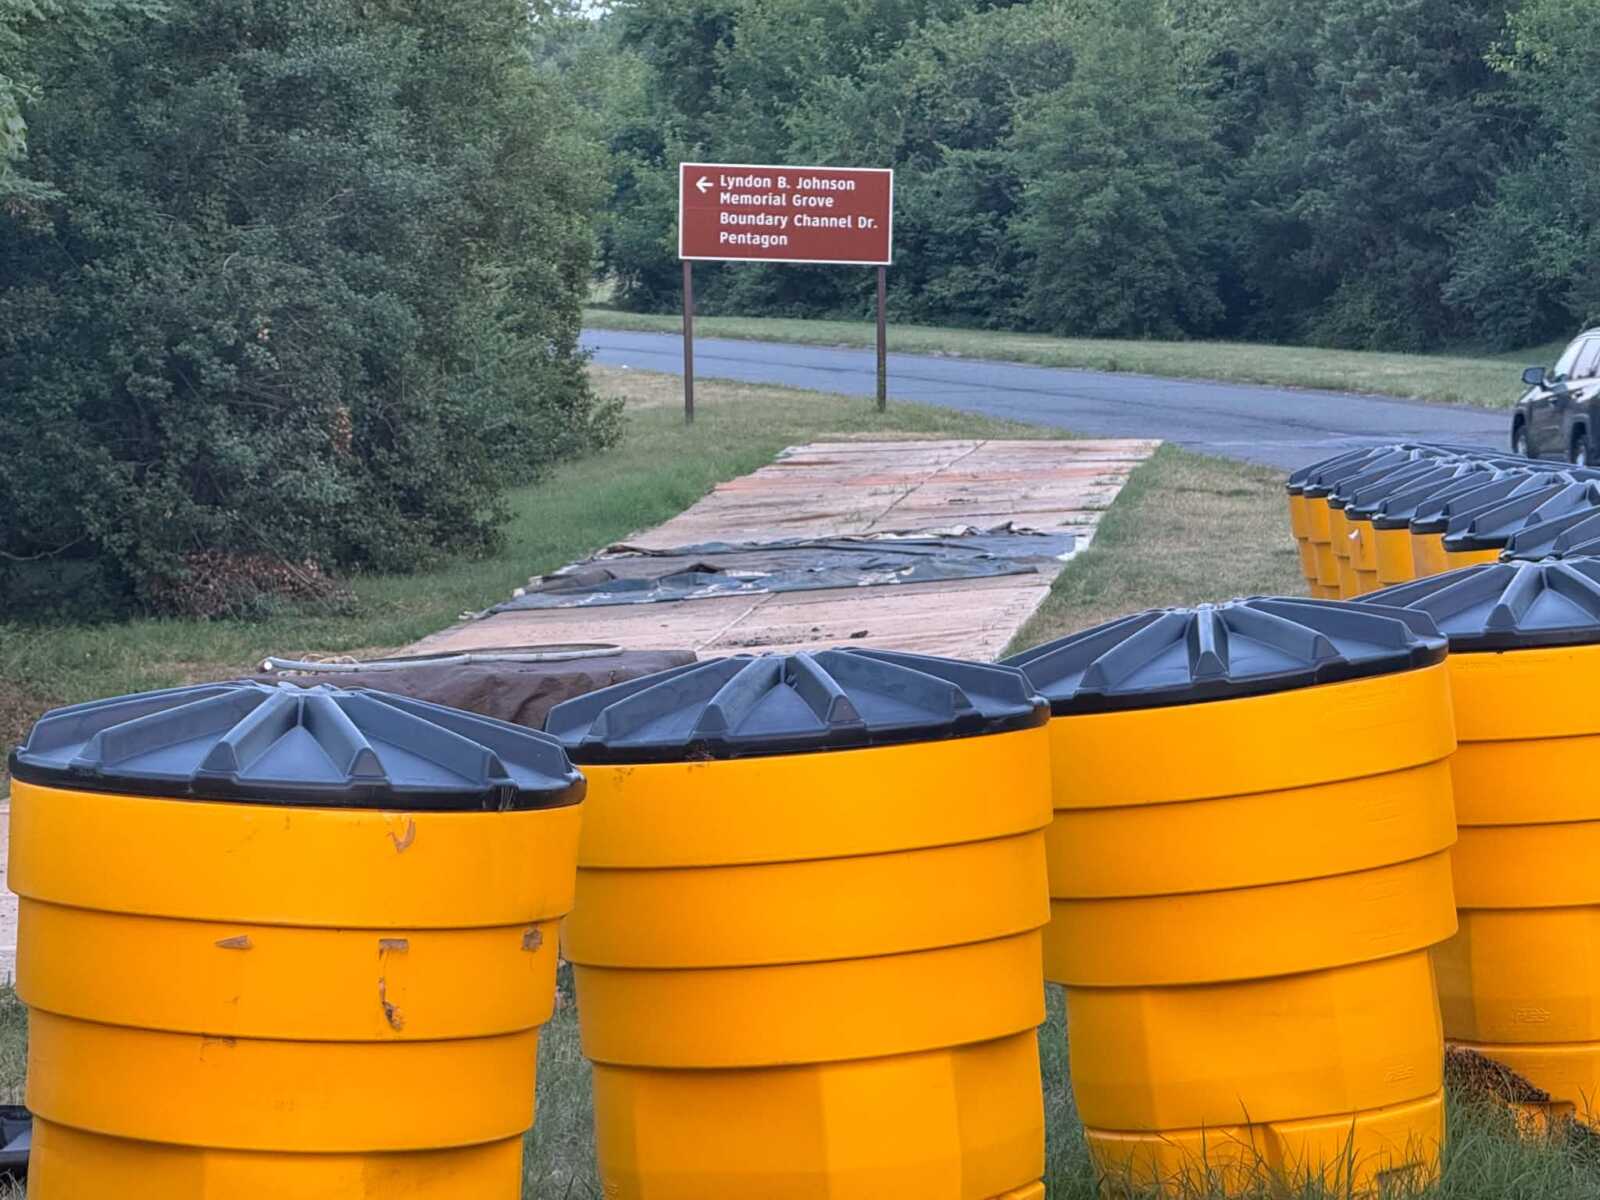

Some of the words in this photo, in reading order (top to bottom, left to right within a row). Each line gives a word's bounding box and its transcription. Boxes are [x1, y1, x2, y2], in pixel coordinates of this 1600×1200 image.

[720, 174, 771, 190] Lyndon
[778, 176, 791, 189] B.
[796, 177, 856, 191] Johnson
[720, 192, 786, 207] Memorial
[792, 194, 834, 208] Grove
[720, 212, 788, 229] Boundary
[794, 214, 852, 228] Channel
[858, 216, 878, 229] Dr.
[720, 232, 788, 248] Pentagon
